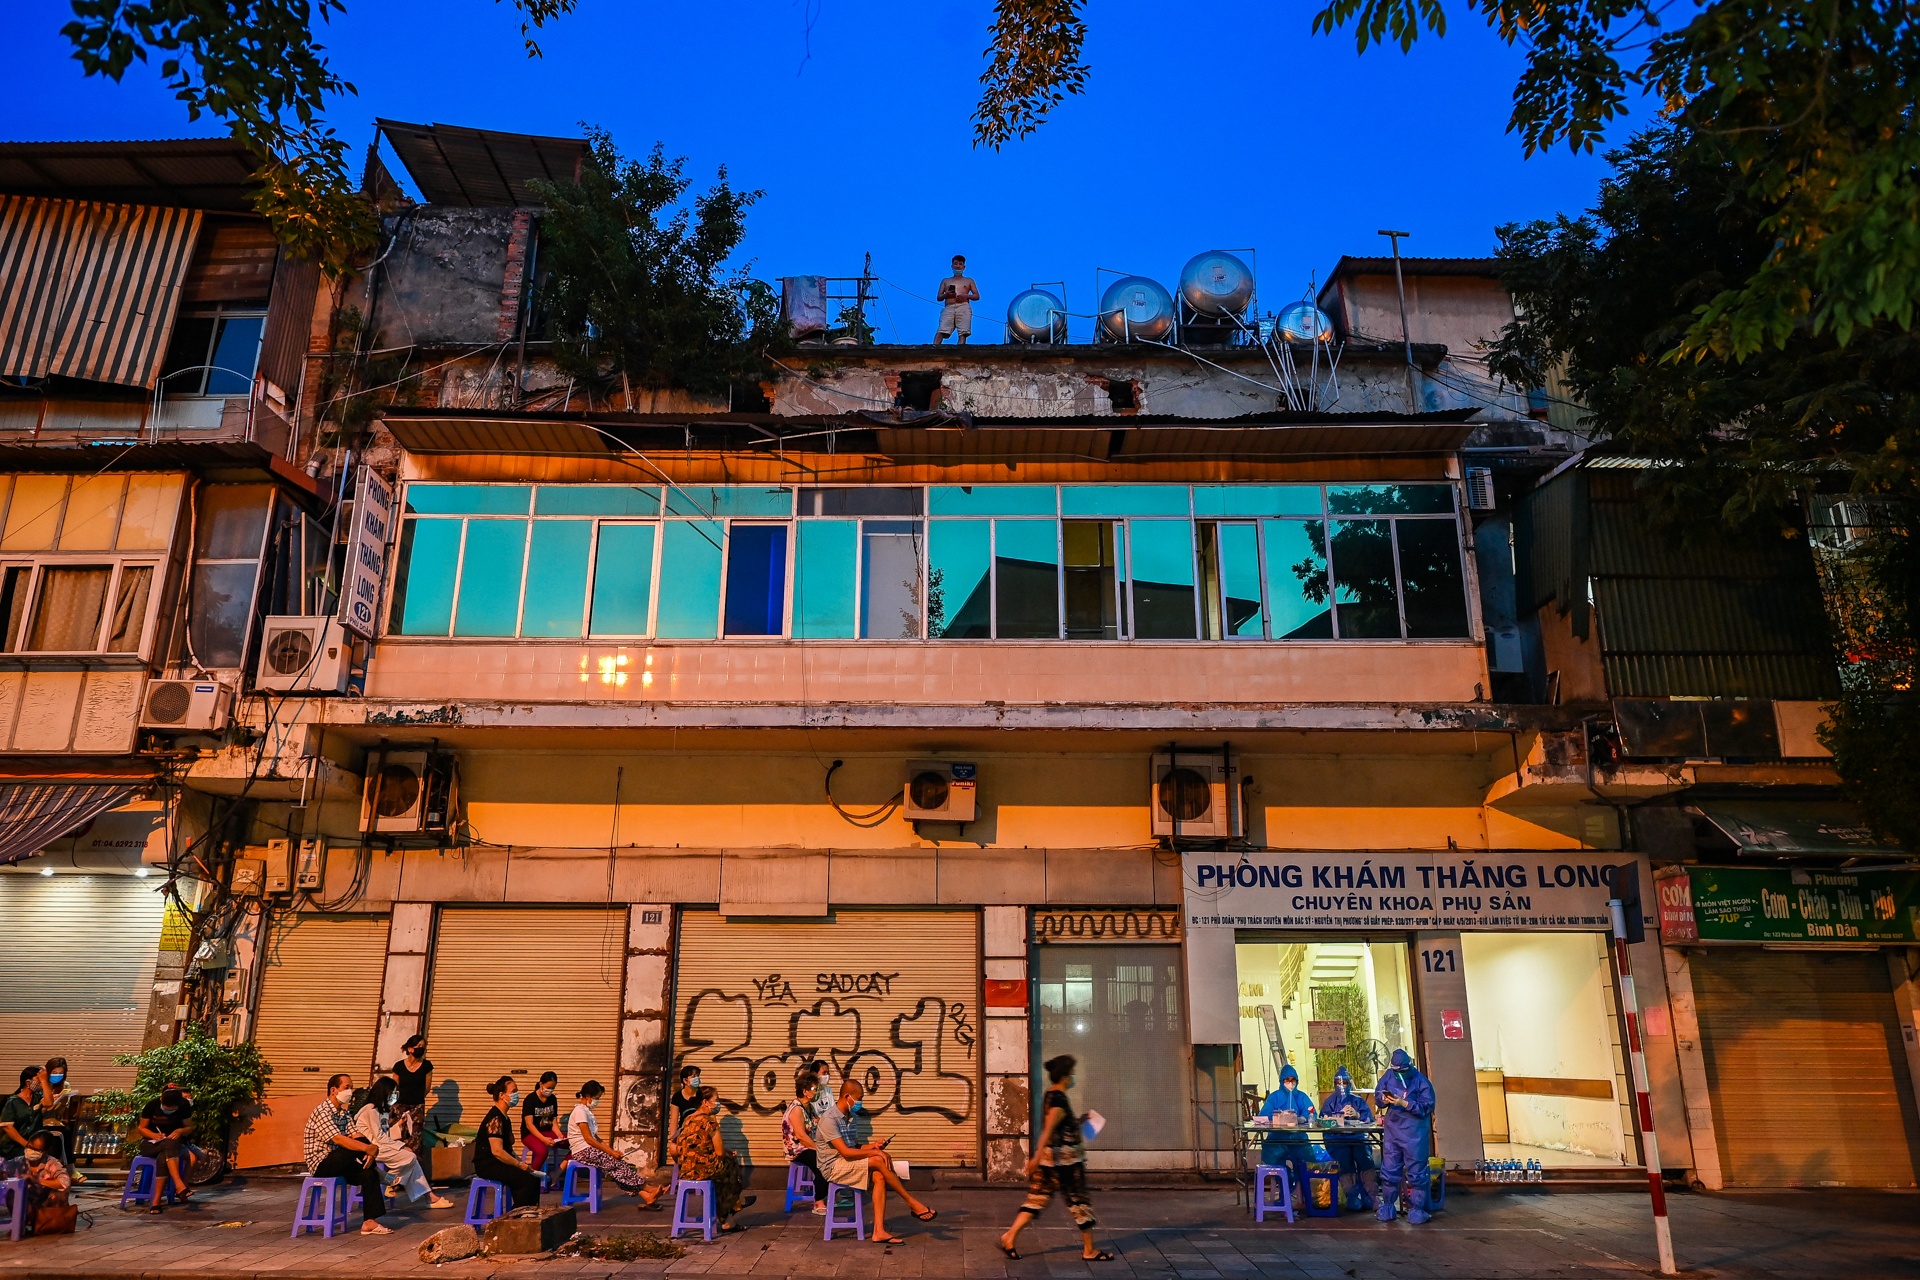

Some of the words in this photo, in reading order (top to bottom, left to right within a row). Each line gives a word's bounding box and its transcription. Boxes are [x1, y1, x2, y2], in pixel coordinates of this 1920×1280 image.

[365, 510, 385, 542] KHÁM
[360, 542, 381, 575] THĂNG
[357, 575, 375, 604] LONG
[357, 603, 369, 622] 121
[1197, 858, 1303, 888] PHÒNG
[1312, 859, 1406, 889] KHÁM
[1415, 859, 1527, 889] THĂNG
[1291, 892, 1373, 911] CHUYÊN
[1379, 896, 1434, 911] KHOA
[1442, 896, 1482, 915] PHỤ
[1489, 890, 1531, 911] SẢN
[1662, 884, 1692, 907] CƠM
[1761, 887, 1790, 919] Cơm
[1798, 888, 1830, 920] Cháo
[1837, 888, 1864, 920] Bún
[1871, 886, 1897, 921] Phở
[644, 913, 660, 923] 121
[1718, 913, 1740, 924] 7UP
[1719, 906, 1732, 914] SAO
[1807, 923, 1834, 937] Bình
[1835, 923, 1859, 937] Dân
[1421, 949, 1456, 973] 121
